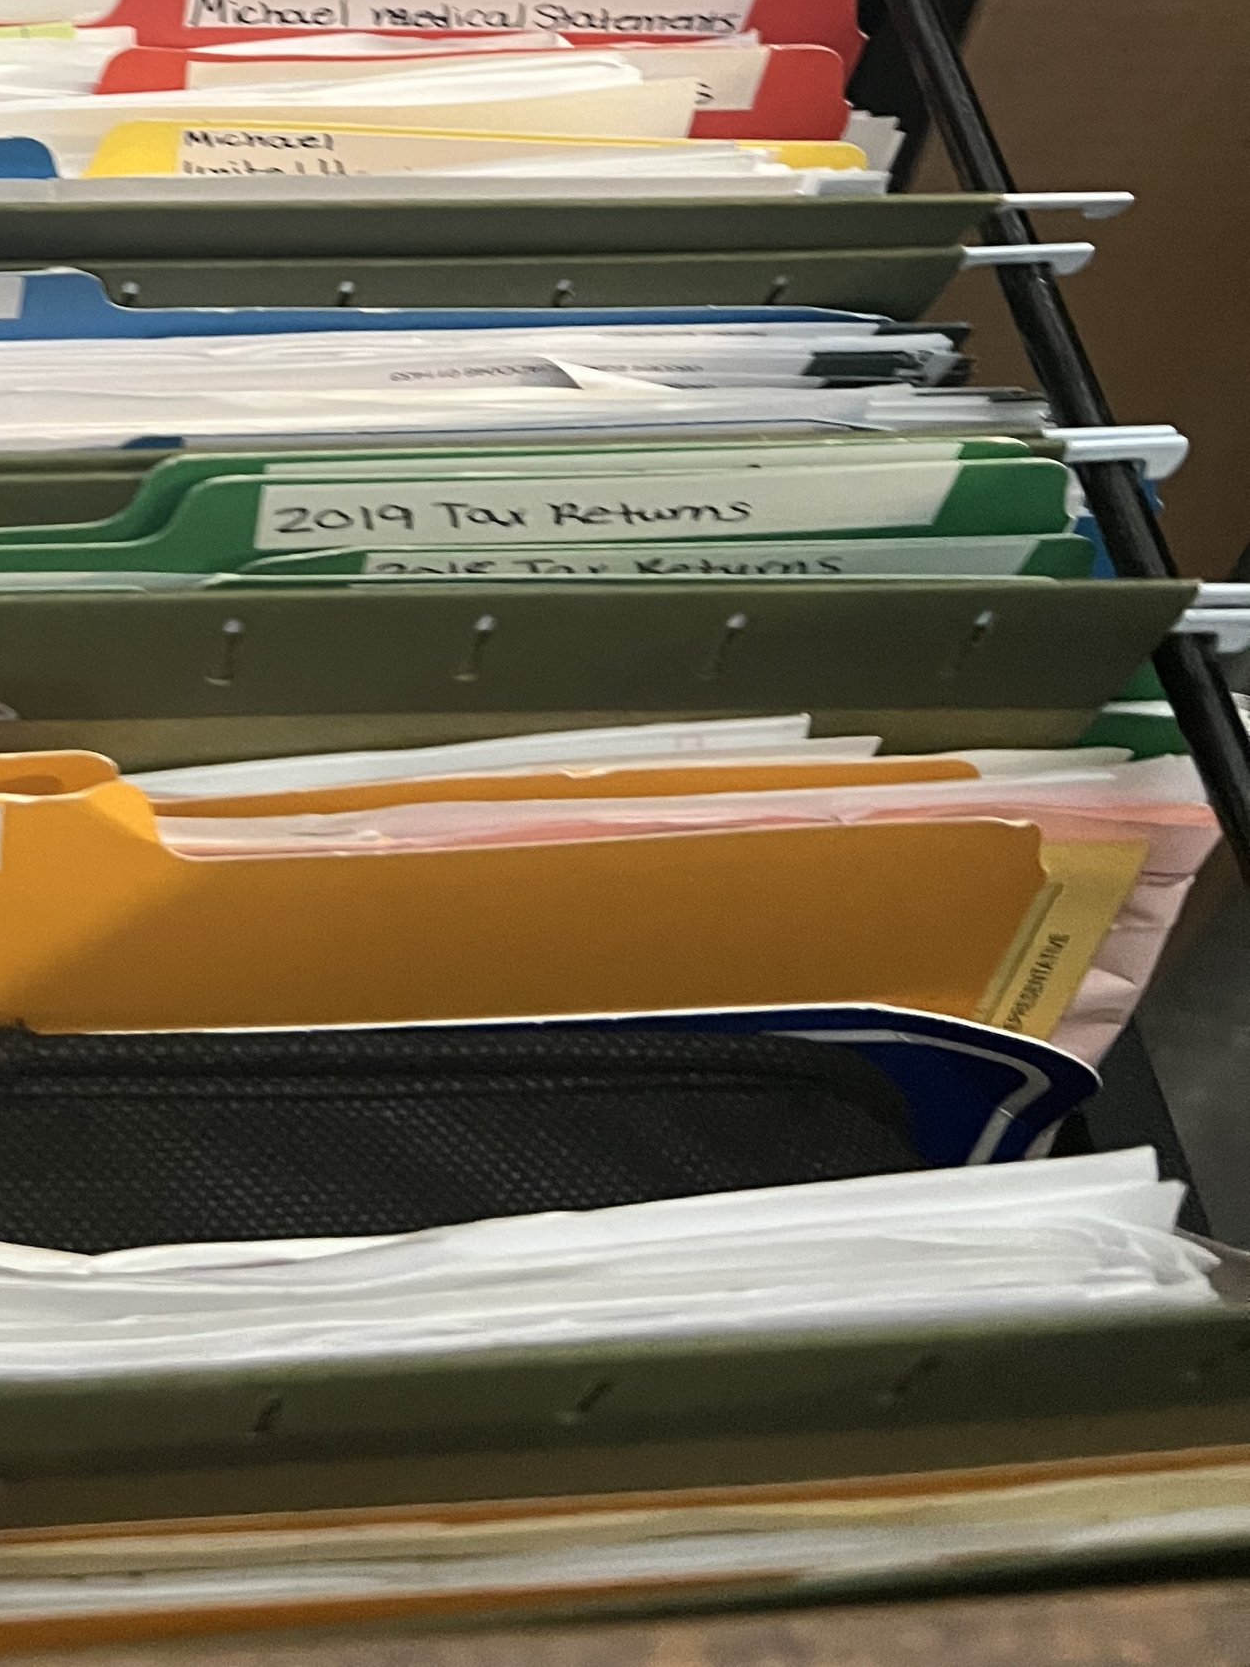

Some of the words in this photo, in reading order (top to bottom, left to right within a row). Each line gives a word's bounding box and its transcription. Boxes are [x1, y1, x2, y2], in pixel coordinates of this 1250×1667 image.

[183, 130, 336, 152] Michael
[273, 503, 415, 534] 2019
[433, 500, 529, 530] Tax
[552, 497, 752, 528] Returns
